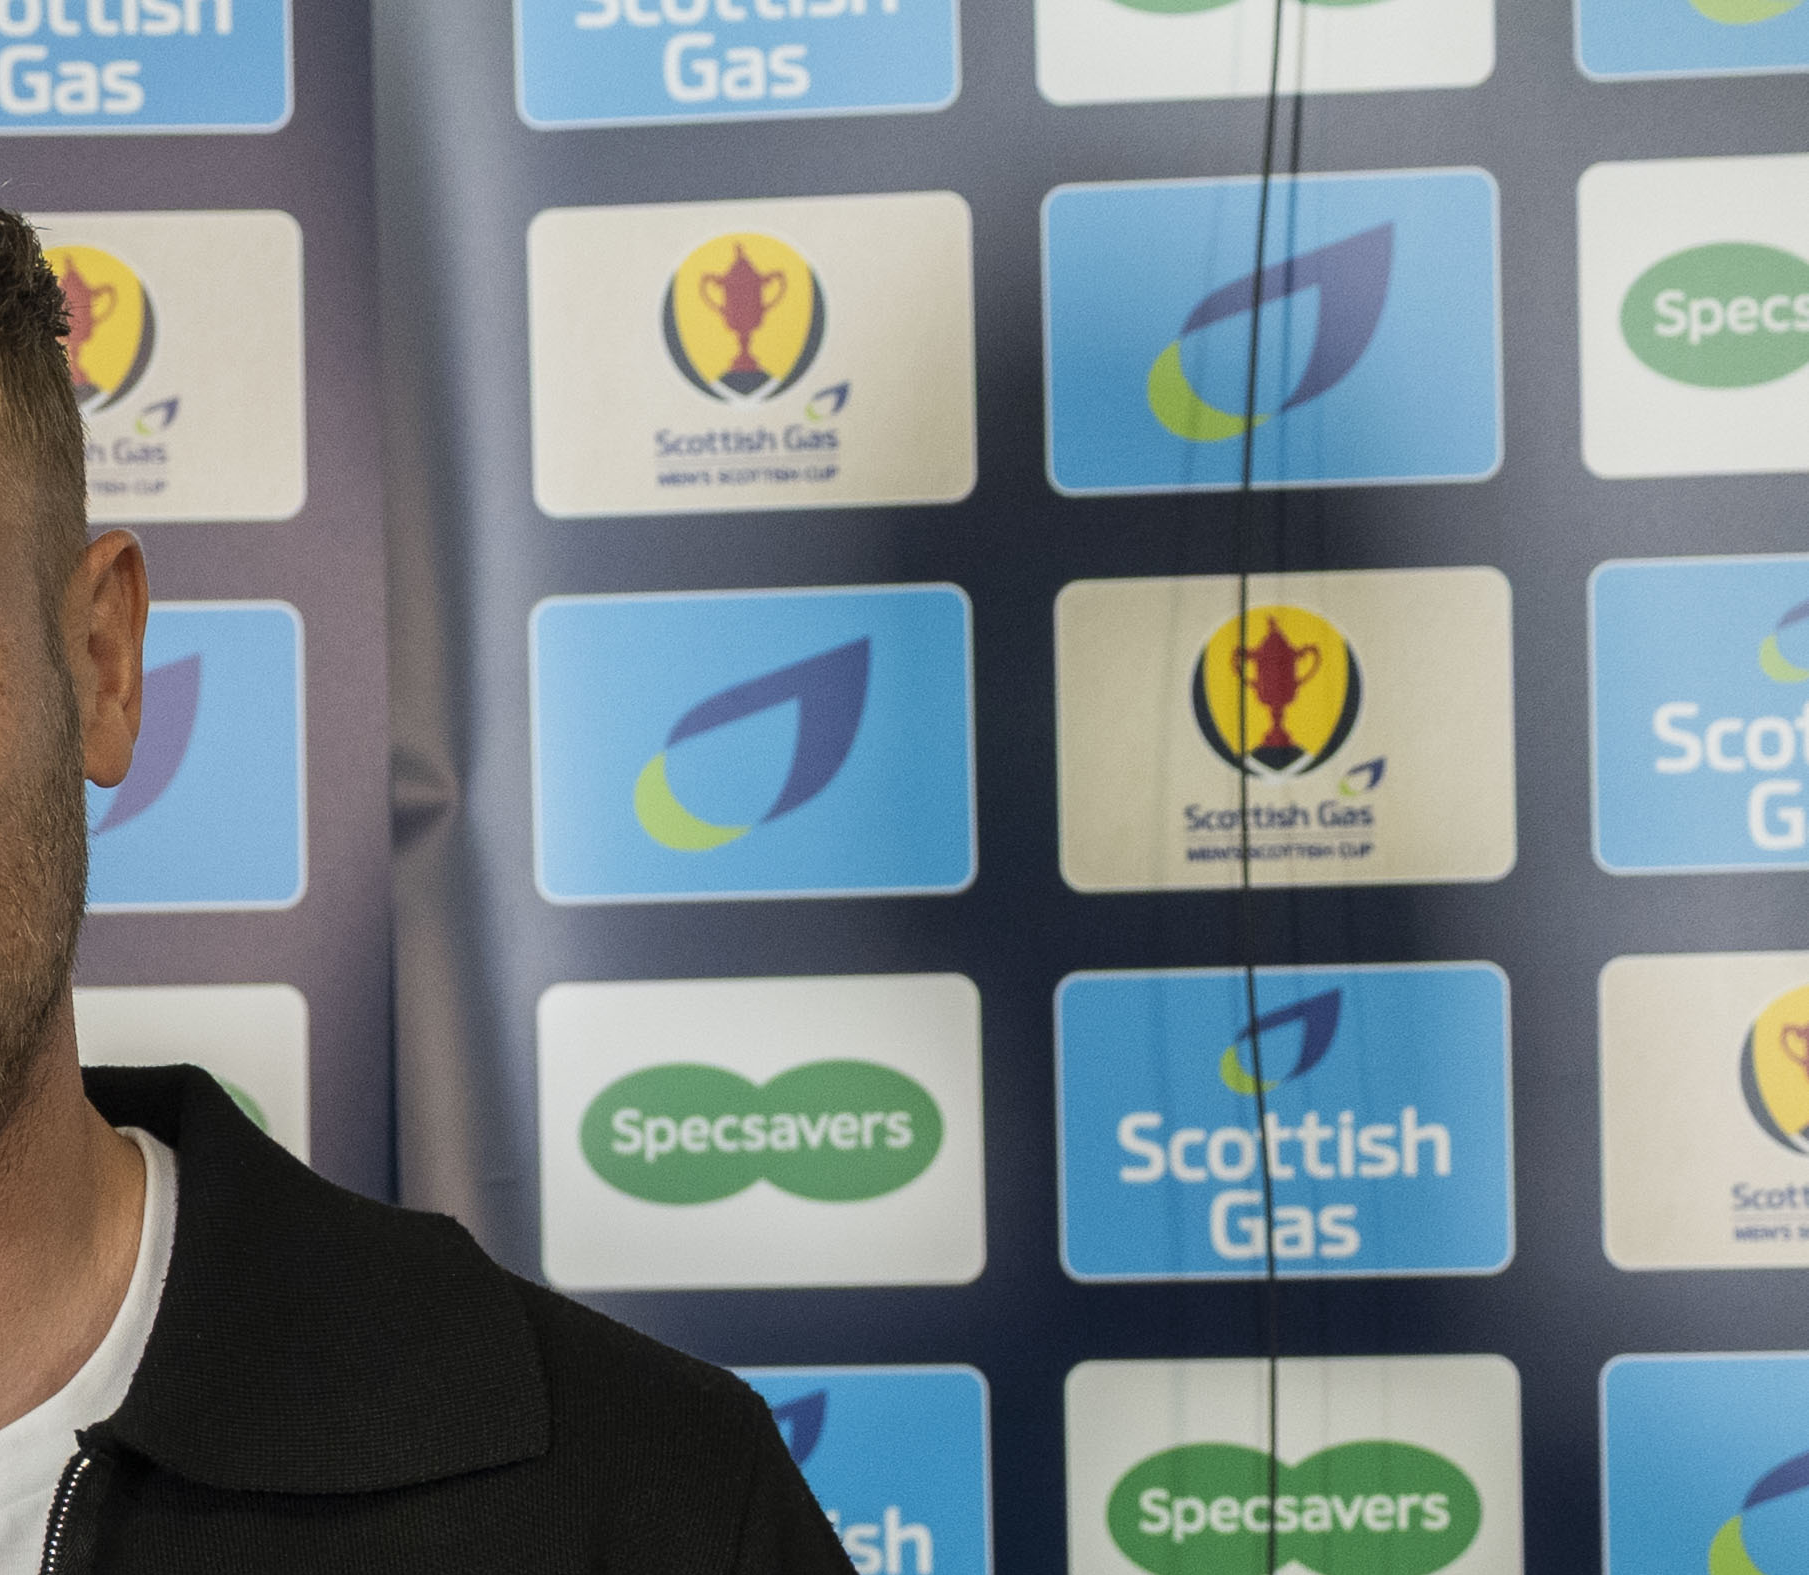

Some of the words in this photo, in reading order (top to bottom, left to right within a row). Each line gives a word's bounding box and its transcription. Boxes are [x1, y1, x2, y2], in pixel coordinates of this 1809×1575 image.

[663, 32, 811, 103] Gas
[111, 438, 168, 466] Gas
[655, 428, 779, 457] Scottish
[783, 425, 841, 452] Gas
[804, 464, 840, 482] CUP
[1184, 801, 1310, 832] Scottish
[1317, 800, 1374, 829] Gas
[1338, 841, 1374, 859] CUP
[611, 1107, 913, 1163] Specsavers
[1117, 1106, 1452, 1183] Scottish
[1209, 1188, 1361, 1260] Gas
[1139, 1487, 1451, 1543] Specsavers
